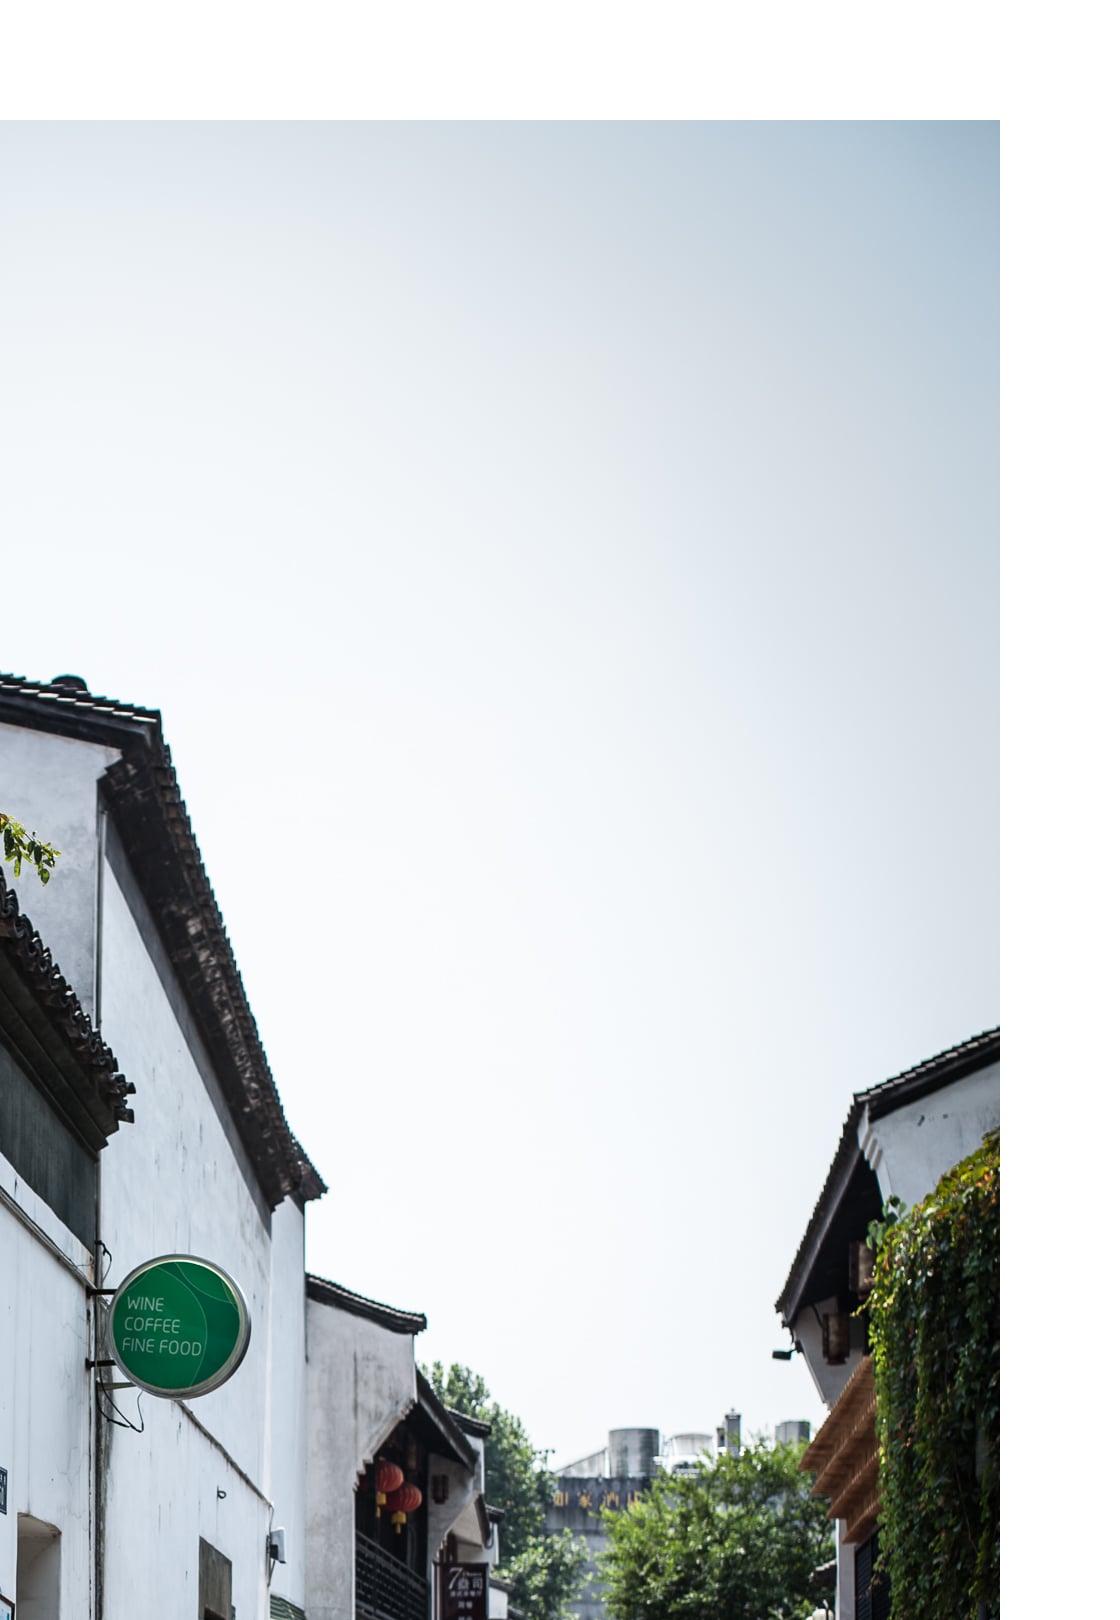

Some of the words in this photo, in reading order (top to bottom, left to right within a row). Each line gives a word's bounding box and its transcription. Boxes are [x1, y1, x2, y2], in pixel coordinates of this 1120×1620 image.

[127, 1296, 165, 1312] WINE
[124, 1317, 180, 1334] COFFEE
[122, 1337, 155, 1353] FINE
[159, 1339, 202, 1356] FOOD
